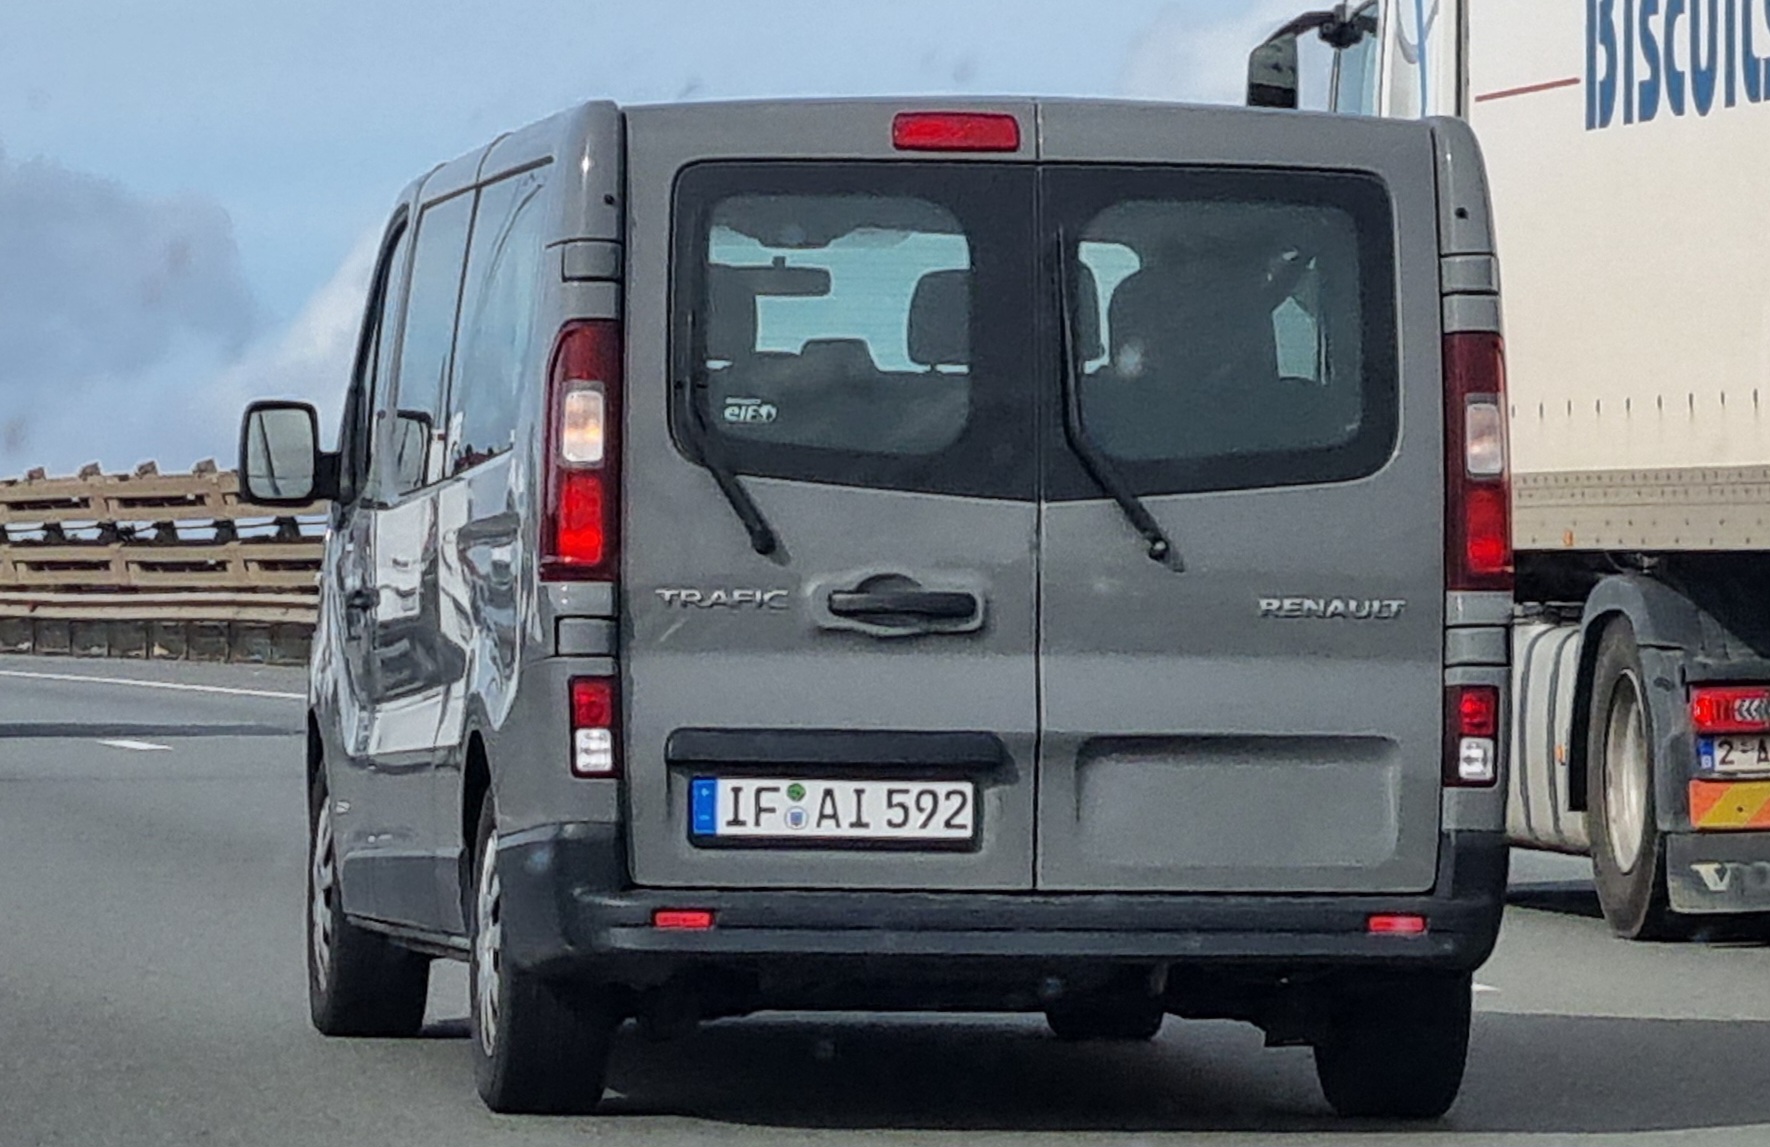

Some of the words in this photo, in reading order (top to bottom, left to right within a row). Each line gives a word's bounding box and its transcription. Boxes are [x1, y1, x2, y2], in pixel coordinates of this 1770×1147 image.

[655, 588, 789, 608] TRAFIC
[1258, 598, 1407, 618] RENAULT
[726, 787, 780, 827] IF
[816, 788, 870, 829] AI
[886, 789, 968, 829] 592
